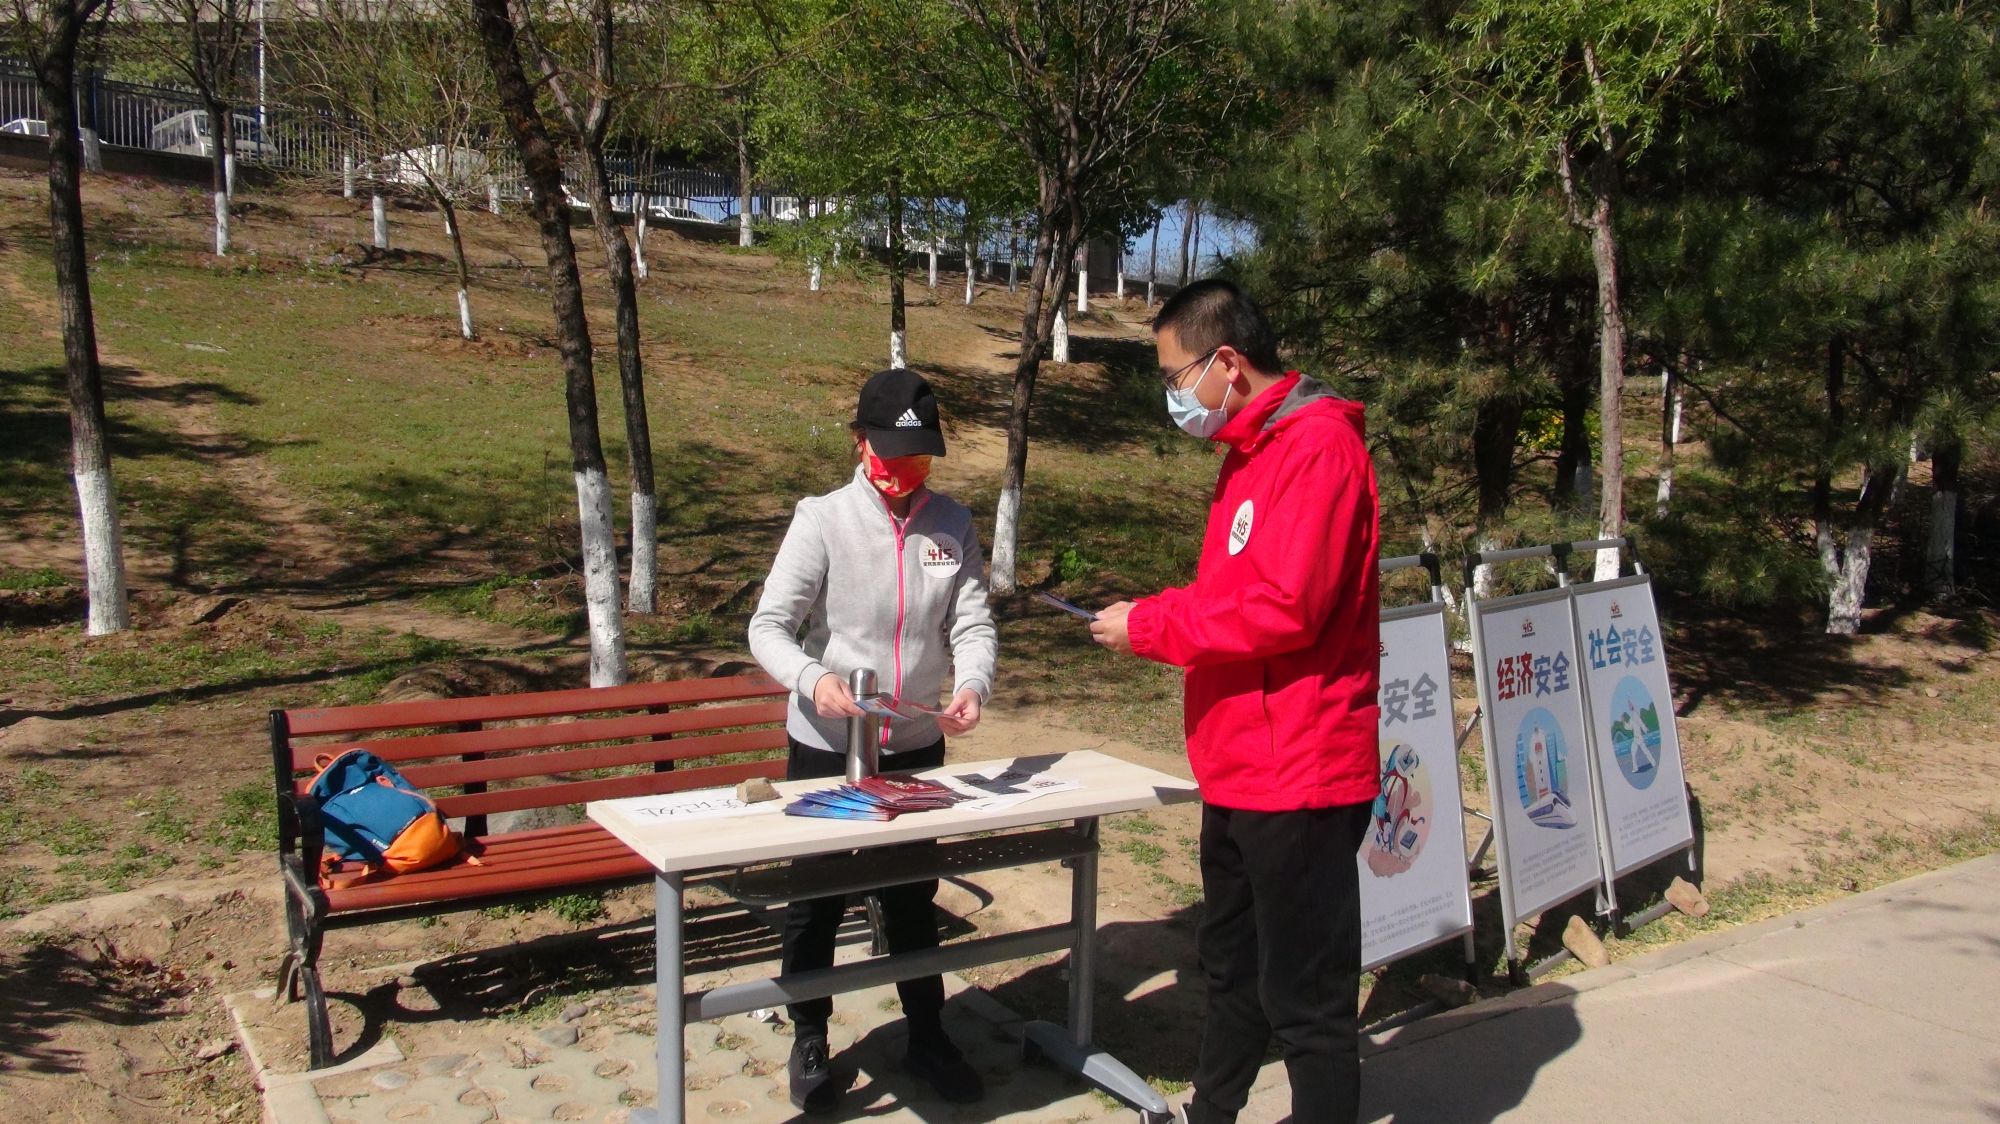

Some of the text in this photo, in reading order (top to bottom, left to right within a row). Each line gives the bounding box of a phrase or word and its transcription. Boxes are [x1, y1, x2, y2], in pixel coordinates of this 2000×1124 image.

[896, 420, 922, 428] adidas
[1589, 623, 1655, 670] 社会安全
[1380, 672, 1438, 727] 安全
[1497, 651, 1570, 702] 经济安全
